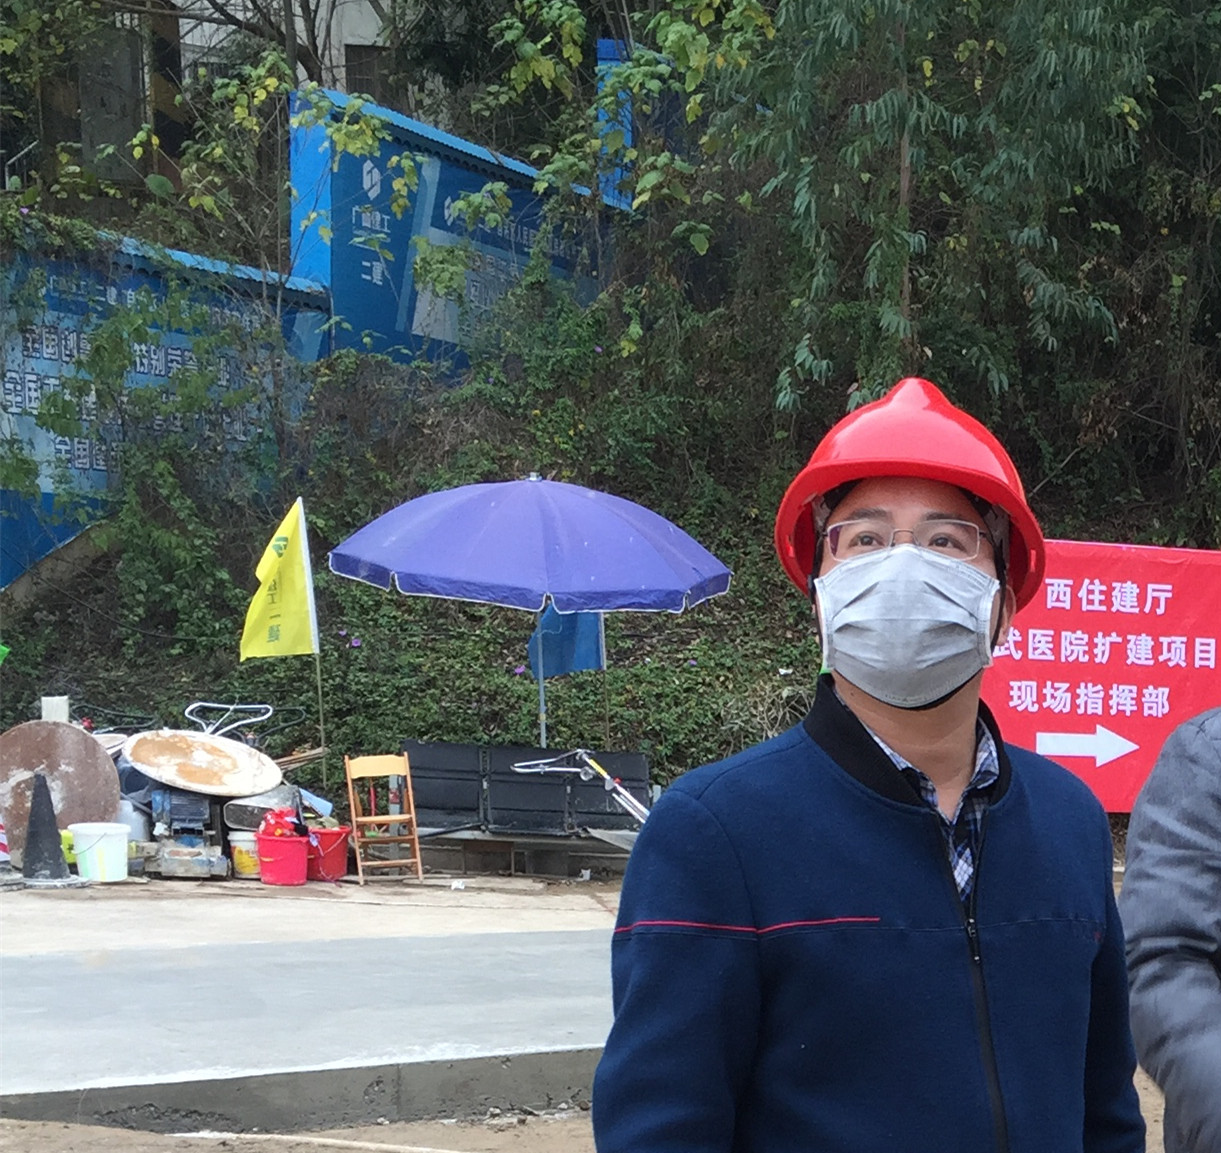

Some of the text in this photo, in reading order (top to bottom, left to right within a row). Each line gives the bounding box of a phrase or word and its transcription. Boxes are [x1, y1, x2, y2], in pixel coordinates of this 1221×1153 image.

[1044, 577, 1173, 616] 西住建厅
[1008, 681, 1170, 718] 现场指挥部
